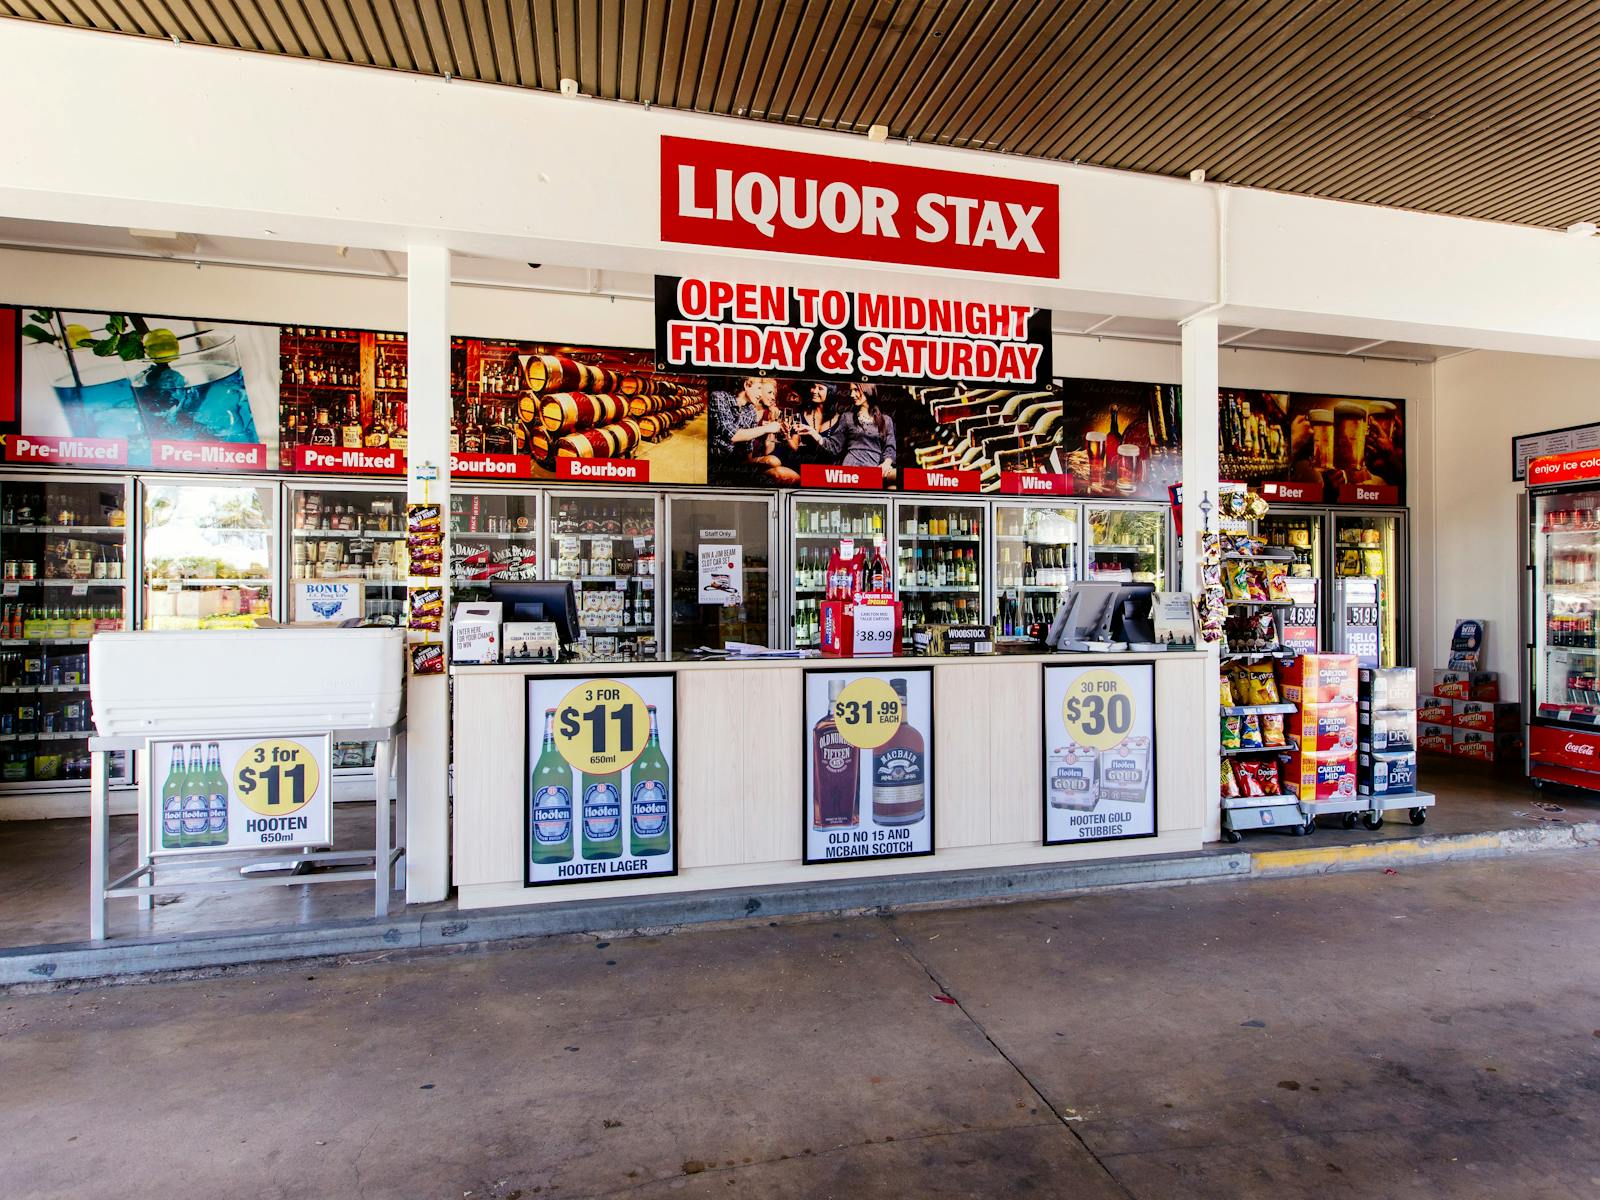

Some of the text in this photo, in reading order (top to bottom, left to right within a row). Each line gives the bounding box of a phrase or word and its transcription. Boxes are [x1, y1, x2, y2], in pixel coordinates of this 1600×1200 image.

[678, 164, 1045, 254] LIQUOR STAX
[679, 277, 1031, 340] OPEN TO MIDNIGHT
[670, 322, 1041, 382] FRIDAY & SATURDAY
[16, 439, 119, 459] Pre-Mixed
[161, 444, 258, 465] Pre-Mixed
[305, 450, 395, 469] Pre-Mixed
[570, 461, 636, 477] Bourbon
[1534, 463, 1561, 474] enjoy
[1563, 461, 1578, 470] ice
[825, 469, 859, 484] Wine
[927, 473, 959, 487] Wine
[1022, 475, 1052, 490] Wine
[1279, 485, 1303, 498] Beer
[1356, 487, 1379, 500] Beer
[724, 548, 736, 557] BEAM
[701, 559, 712, 567] SLOT
[306, 584, 349, 593] BONUS
[457, 626, 481, 636] ENTER HERE
[856, 630, 892, 642] $38.99
[948, 629, 986, 638] WOODSTOCK
[457, 635, 465, 643] FOR
[465, 633, 477, 642] YOUR
[1349, 633, 1377, 643] HELLO
[1349, 644, 1377, 656] BEER
[1319, 669, 1347, 677] CARLTON
[1326, 676, 1340, 684] MID
[1081, 681, 1117, 693] 30 FOR
[585, 689, 620, 701] 3 FOR
[879, 715, 899, 724] EACH
[1066, 694, 1132, 735] $30
[1459, 714, 1487, 724] SuperDry
[560, 703, 634, 753] $11
[819, 734, 830, 749] OLD
[1389, 730, 1410, 741] DRY
[254, 746, 300, 763] 3 for
[823, 748, 850, 760] FIFTEEN
[1459, 744, 1487, 754] SuperDry
[590, 755, 616, 764] 650ml
[880, 749, 917, 764] MACBAIN
[1317, 765, 1346, 773] CARLTON
[1108, 770, 1139, 781] GOLD
[1324, 772, 1339, 780] MID
[1389, 772, 1412, 783] DRY
[238, 763, 305, 806] $11
[1054, 779, 1087, 790] GOLD
[246, 816, 307, 832] HOOTEN
[1070, 812, 1132, 826] HOOTEN GOLD
[828, 828, 910, 844] OLD NO 15 AND
[1079, 825, 1123, 837] STUBBIES
[261, 832, 293, 843] 650ml
[825, 841, 913, 858] MCBAIN SCOTCH
[558, 859, 648, 877] HOOTEN LAGER
